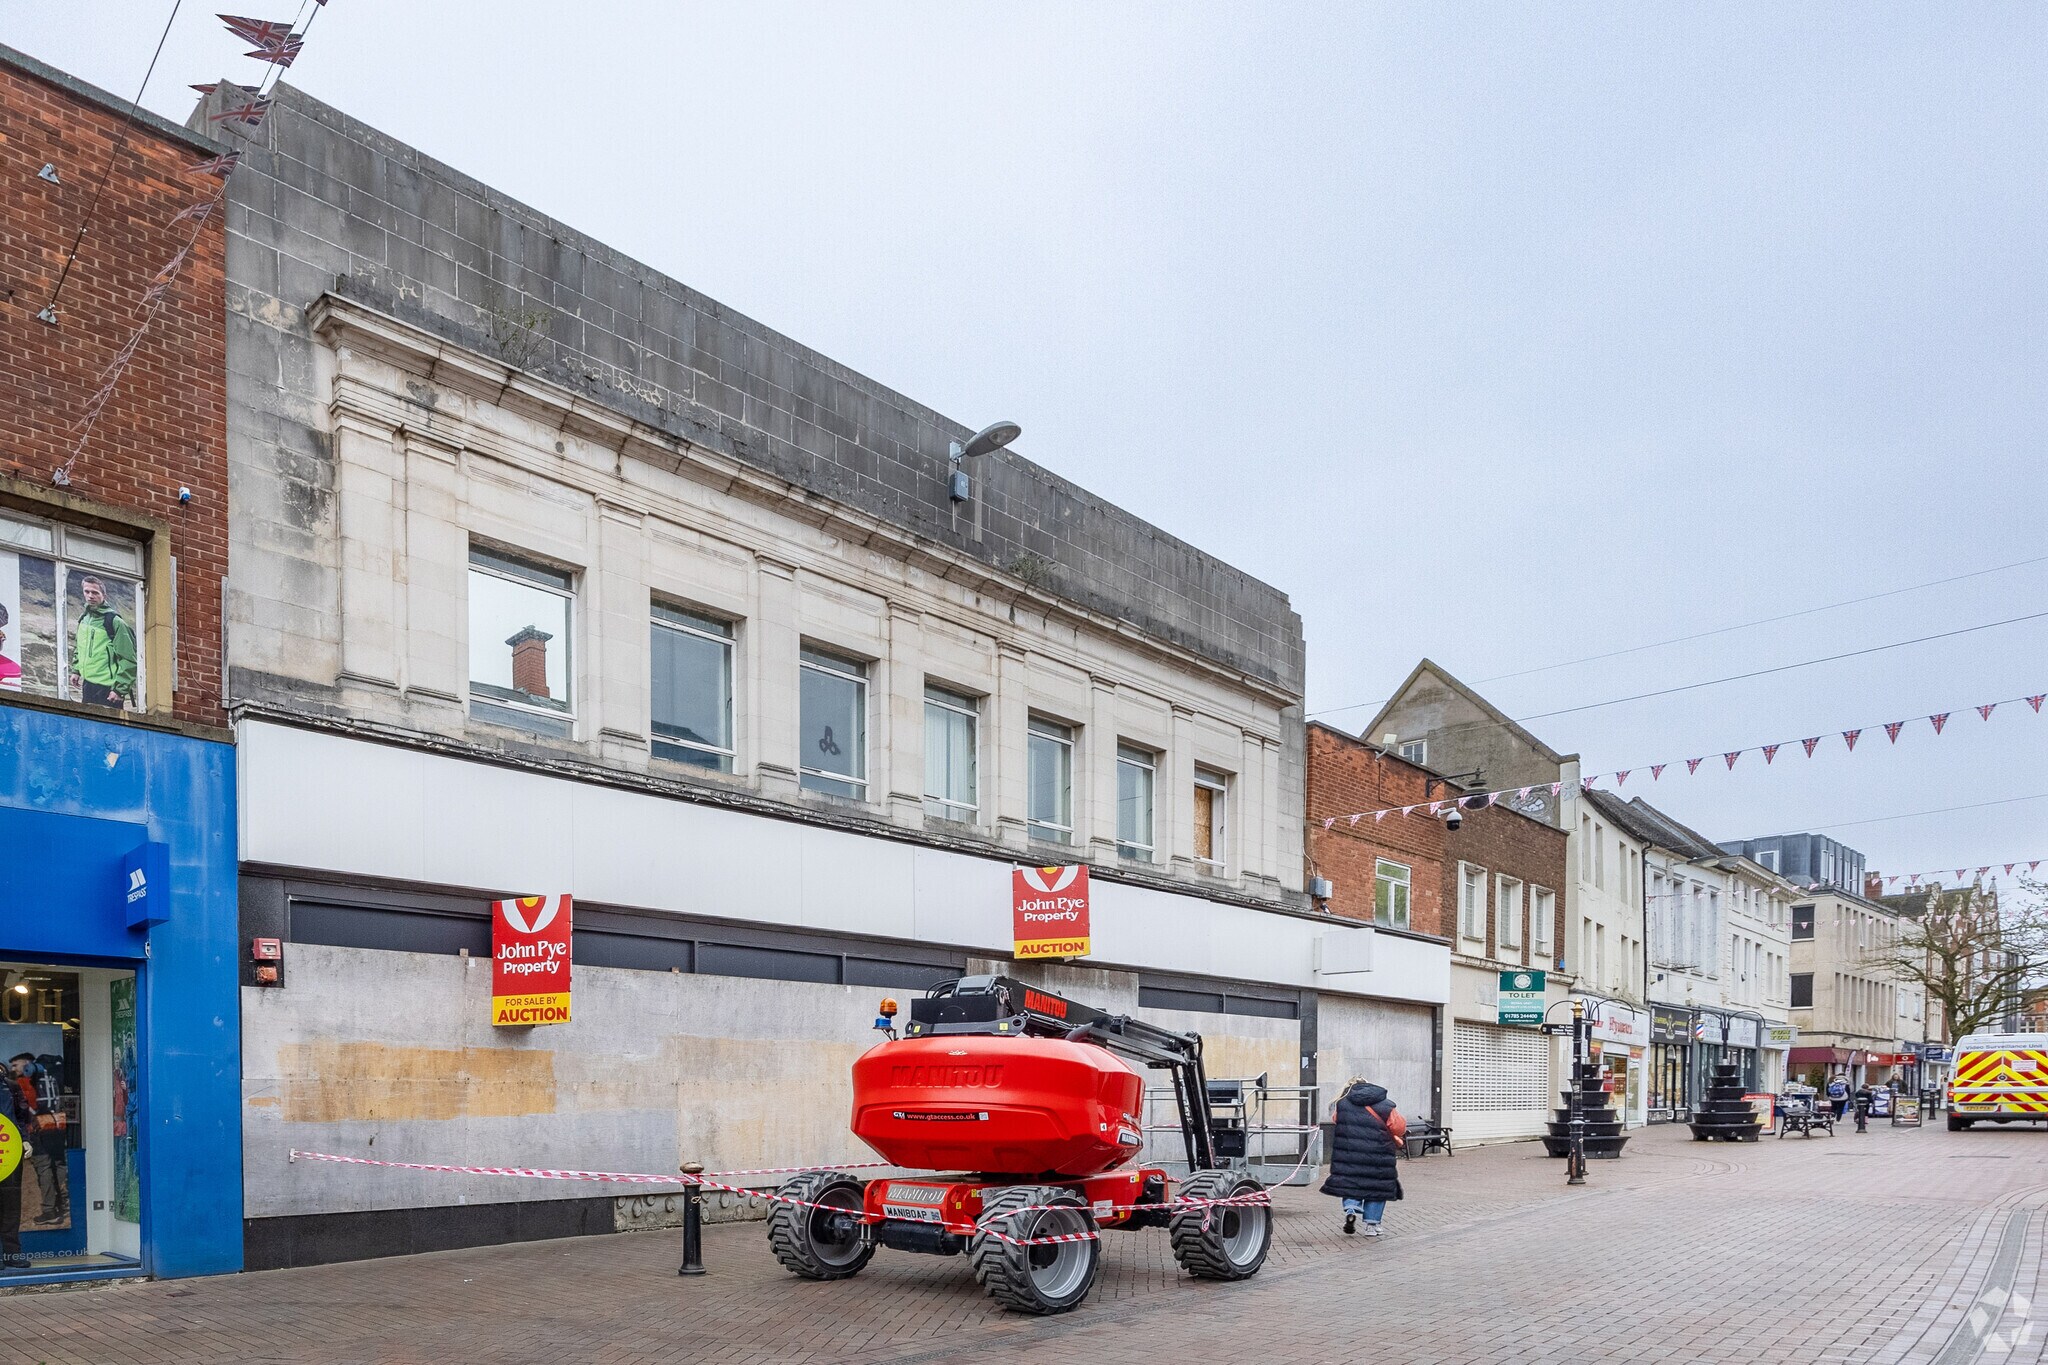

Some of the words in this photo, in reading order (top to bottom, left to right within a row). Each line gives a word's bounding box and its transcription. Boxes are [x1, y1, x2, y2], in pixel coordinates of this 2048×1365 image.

[1018, 898, 1055, 912] John
[1057, 897, 1085, 912] Pye
[1024, 911, 1079, 923] Property
[497, 942, 535, 960] John
[537, 941, 567, 960] Pye
[1020, 942, 1085, 955] AUCTION
[503, 960, 560, 976] Property
[505, 998, 522, 1006] FOR
[524, 997, 545, 1006] SALE
[547, 996, 557, 1004] BY
[1024, 989, 1068, 1019] MANITOU
[498, 1007, 568, 1023] AUCTION
[891, 1065, 1004, 1089] MANITOU
[907, 1112, 976, 1121] www.gtaccess.co.uk
[887, 1187, 947, 1202] MANITOU
